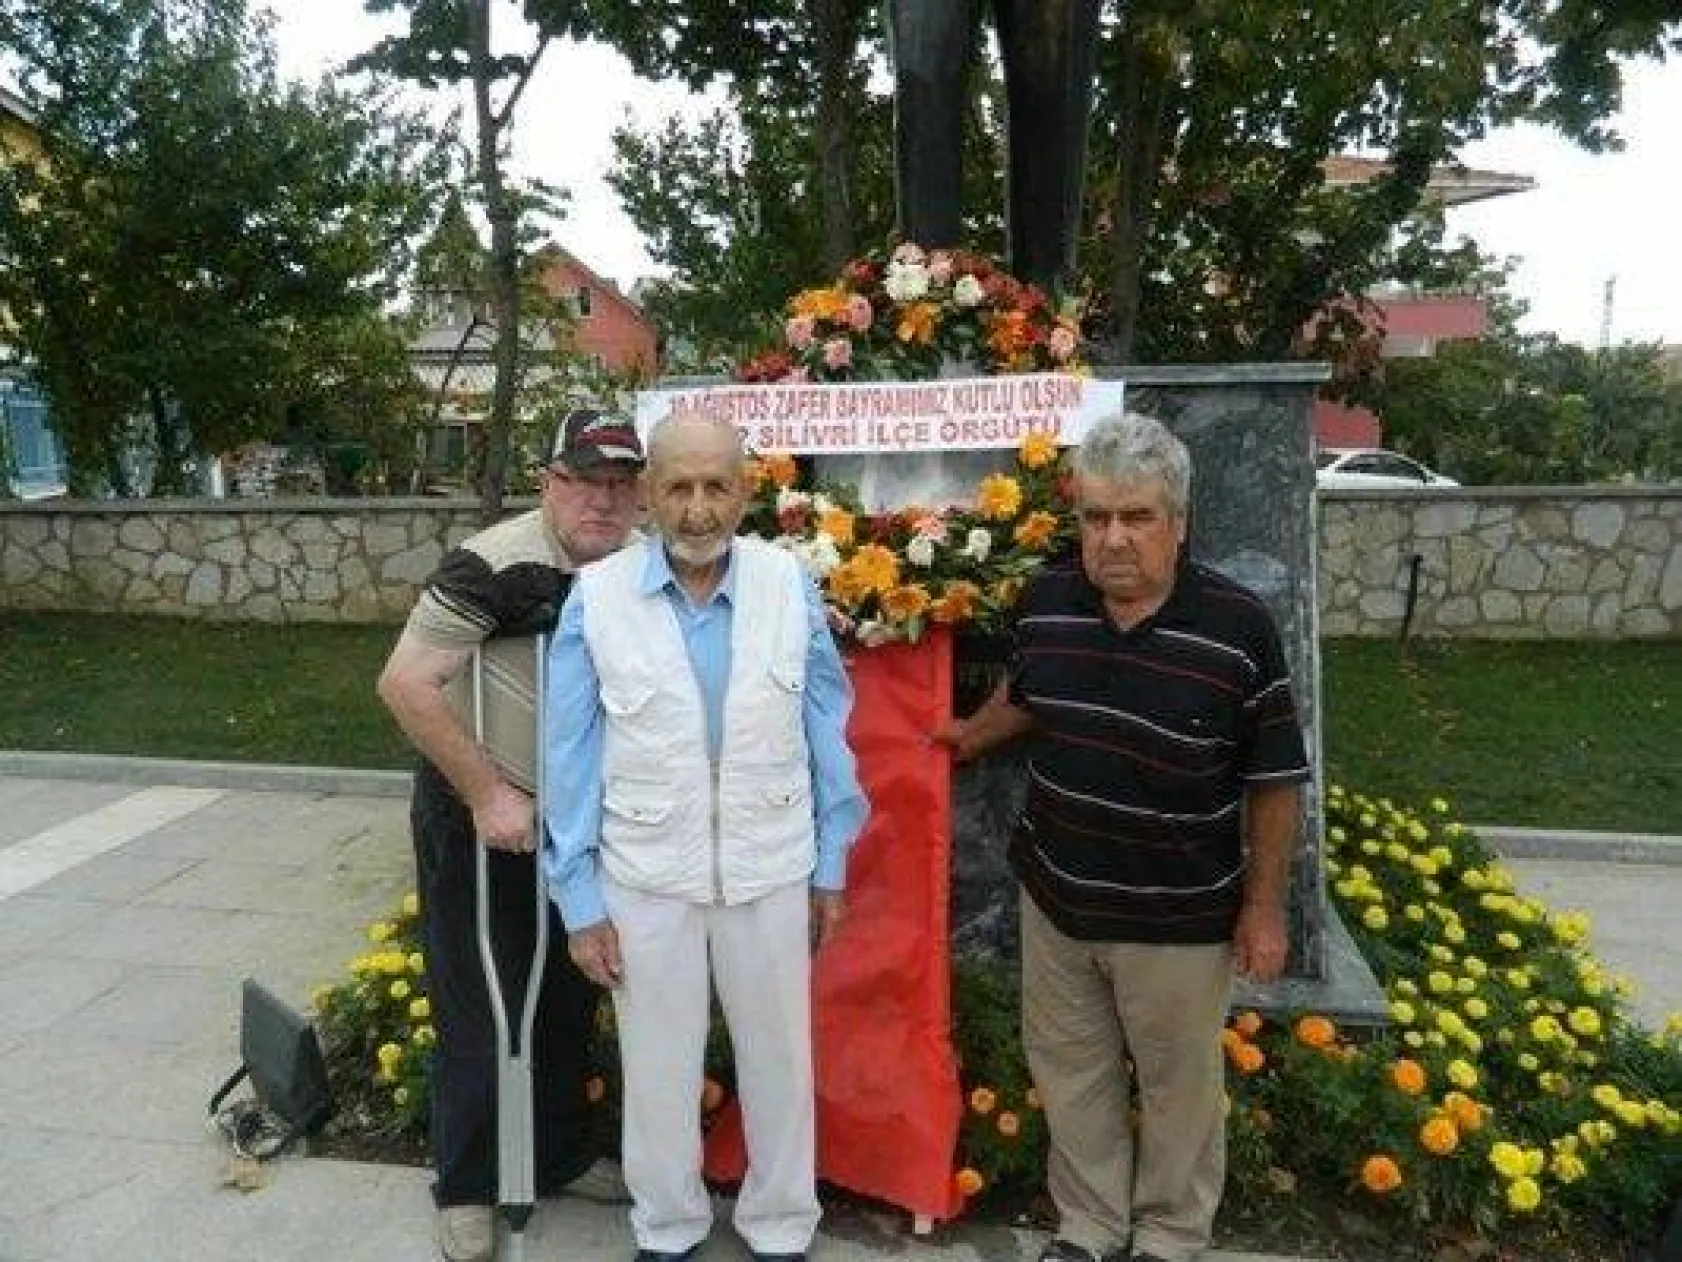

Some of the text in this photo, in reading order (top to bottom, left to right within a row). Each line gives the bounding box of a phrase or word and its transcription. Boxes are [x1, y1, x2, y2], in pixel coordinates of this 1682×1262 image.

[775, 388, 830, 418] ZAFER
[952, 380, 1014, 413] KUTLU
[1021, 376, 1082, 409] OLSUN
